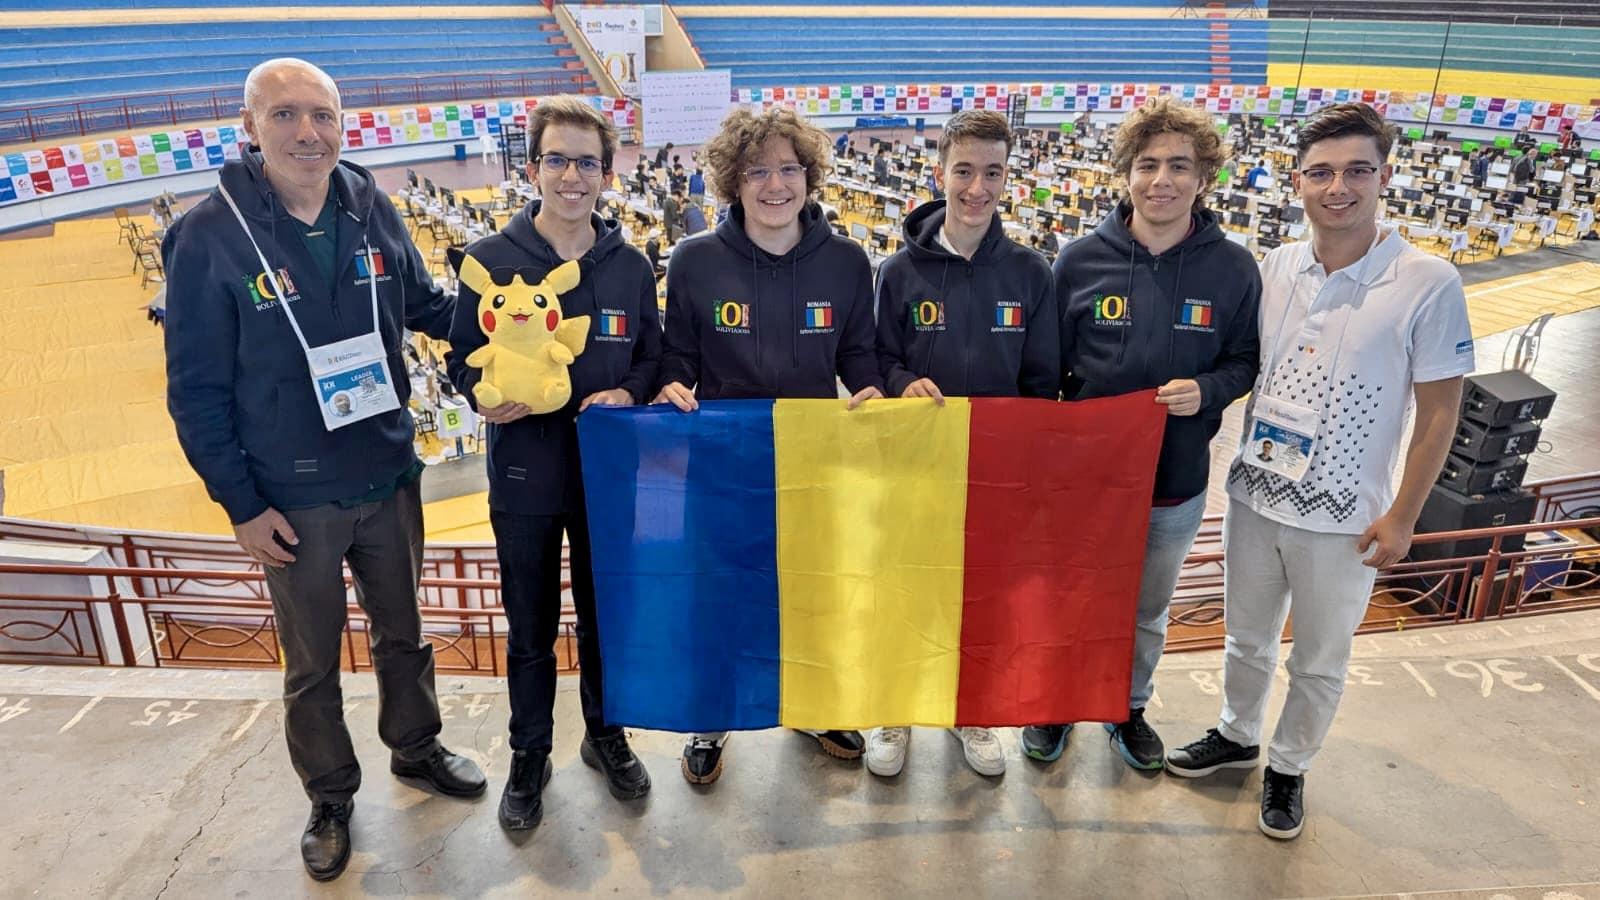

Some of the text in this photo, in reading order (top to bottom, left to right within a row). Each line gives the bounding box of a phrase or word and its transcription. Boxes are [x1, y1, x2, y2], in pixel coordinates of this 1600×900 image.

[447, 412, 458, 426] B
[1344, 664, 1384, 687] 3
[1444, 658, 1544, 698] 36
[130, 700, 200, 727] 45
